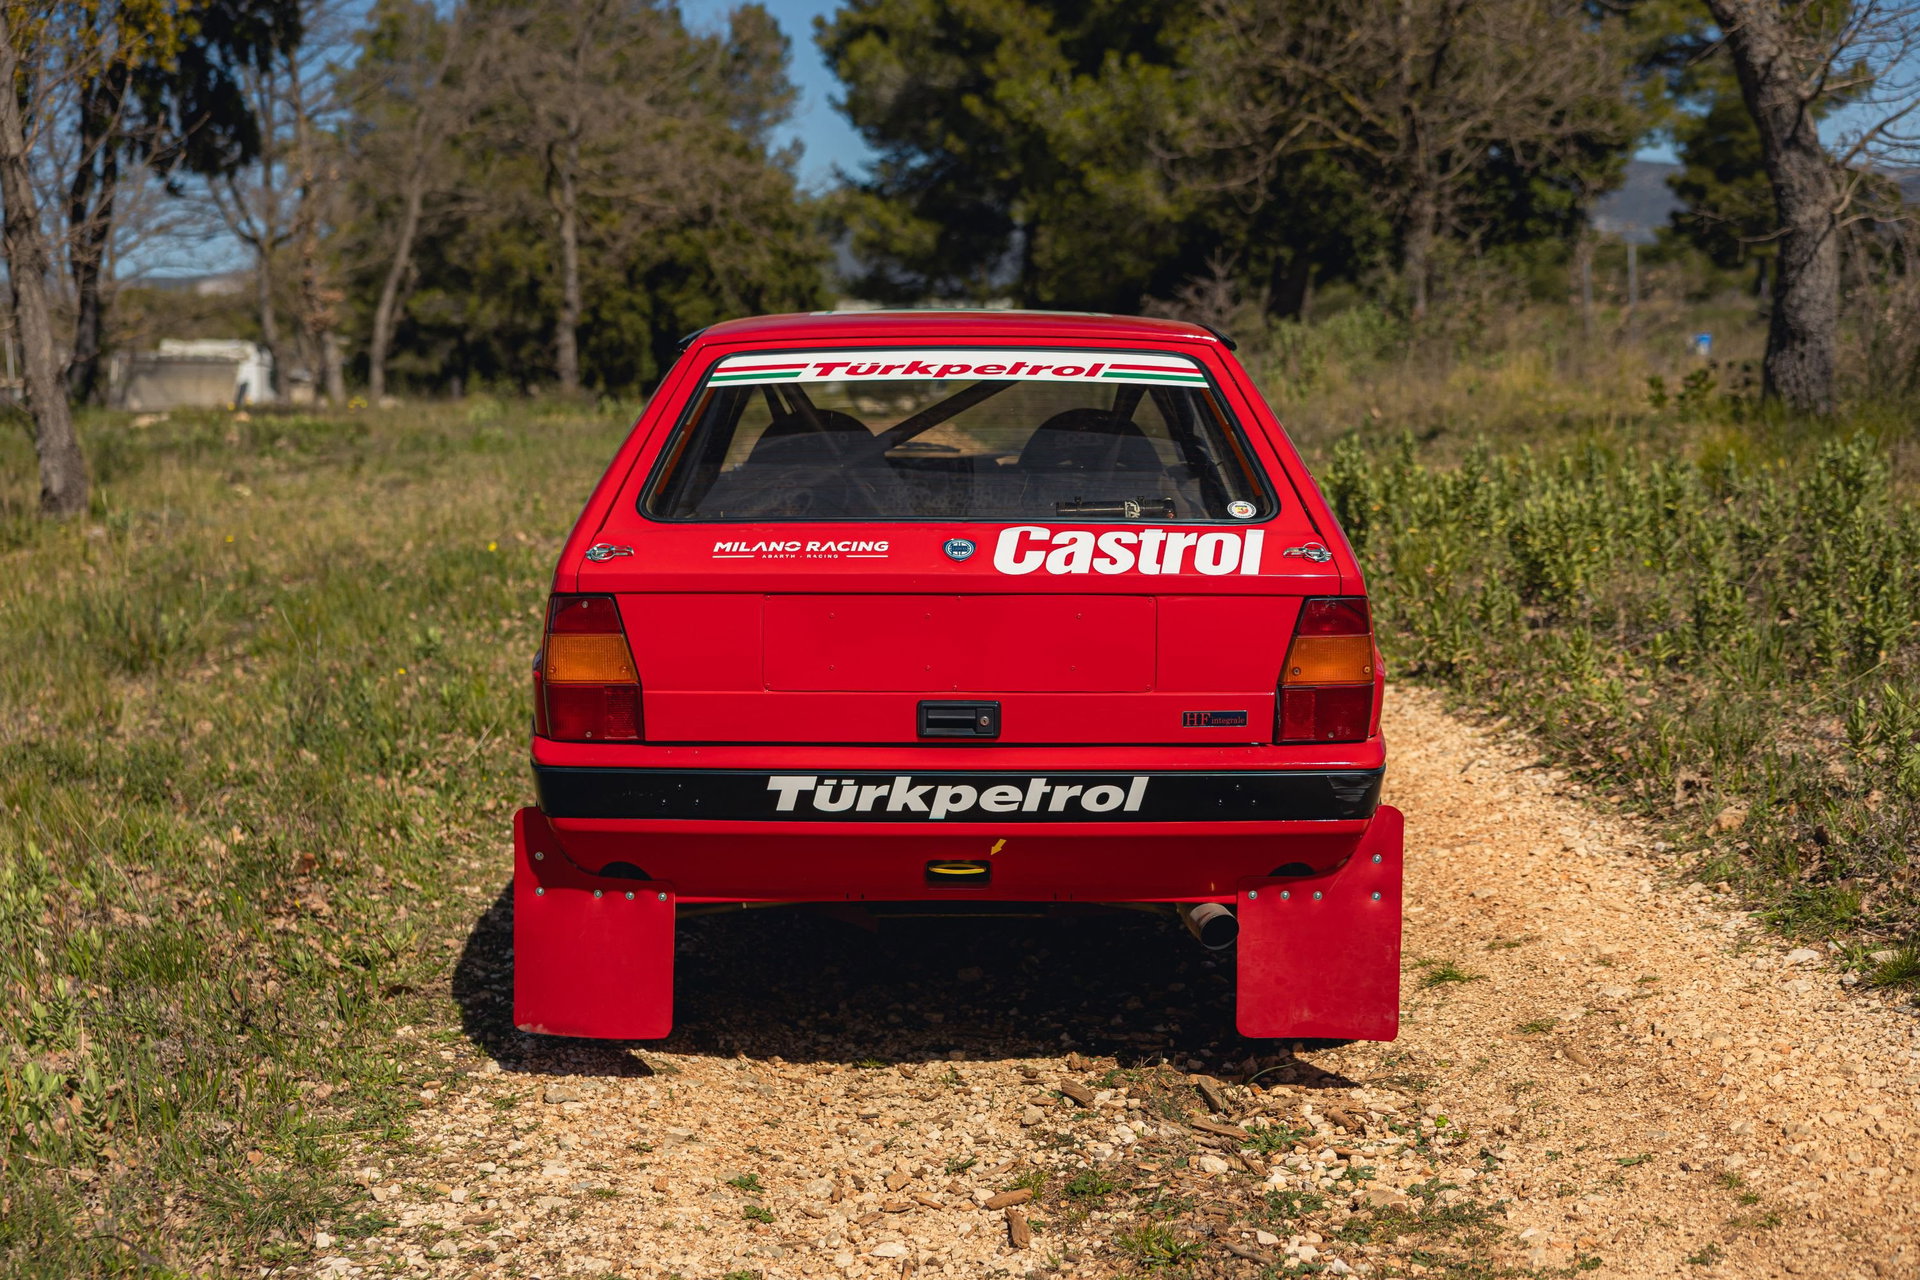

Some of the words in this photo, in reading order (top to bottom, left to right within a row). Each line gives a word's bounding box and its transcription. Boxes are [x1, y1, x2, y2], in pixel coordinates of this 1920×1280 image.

[812, 360, 1106, 378] Türkpetrol
[713, 541, 802, 552] MILANO
[805, 540, 889, 552] RACING
[993, 526, 1265, 576] Castrol
[1186, 712, 1211, 726] HF
[766, 775, 1150, 820] Türkpetrol
